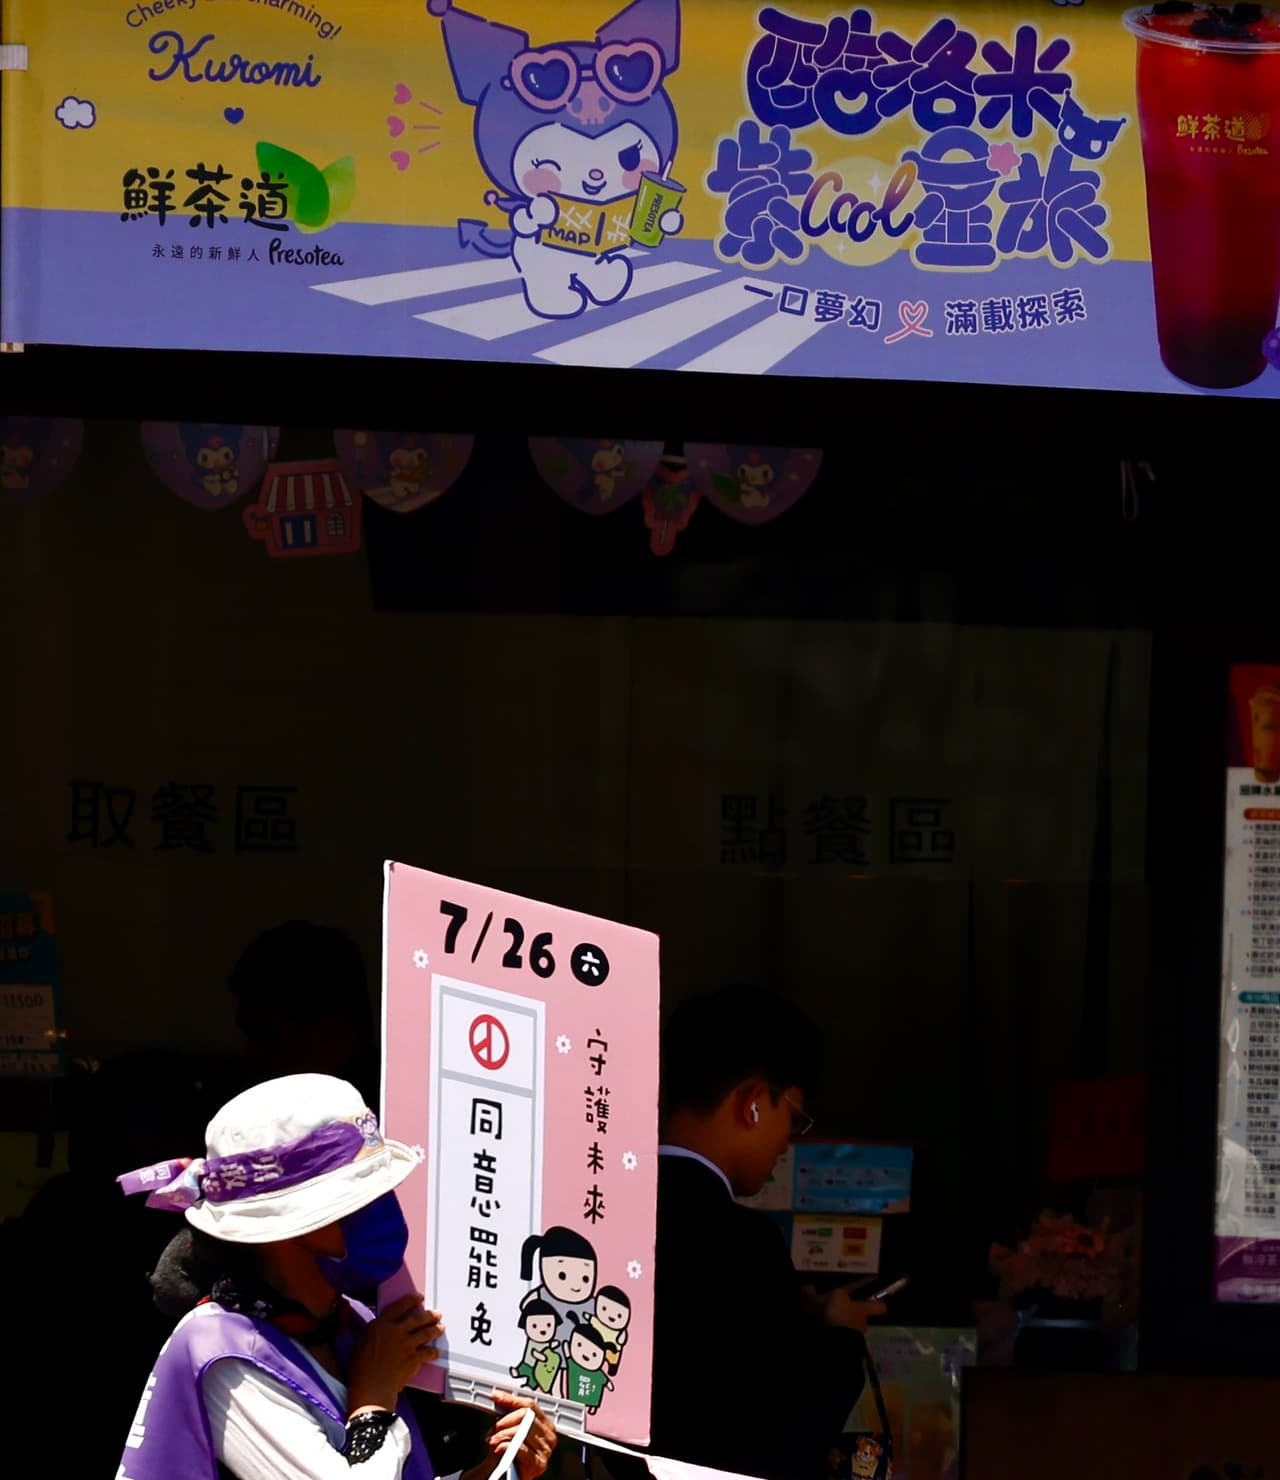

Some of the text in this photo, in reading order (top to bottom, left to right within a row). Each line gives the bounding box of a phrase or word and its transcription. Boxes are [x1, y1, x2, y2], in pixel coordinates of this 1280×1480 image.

[248, 0, 342, 40] arming!
[148, 30, 322, 88] Kuromi
[747, 8, 1075, 138] 酷洛米
[1176, 113, 1246, 142] 鮮茶道
[120, 162, 290, 232] 鮮茶道
[152, 244, 261, 262] 永遠的新鮮人
[268, 238, 345, 266] Presotea
[548, 227, 591, 246] MAP
[743, 284, 1087, 336] 一口夢幻 滿載探索
[66, 780, 299, 853] 取餐區
[720, 794, 956, 866] 點餐區
[438, 899, 556, 979] 7/26
[583, 1028, 612, 1224] 守護未來
[466, 1097, 504, 1347] 同意罷免
